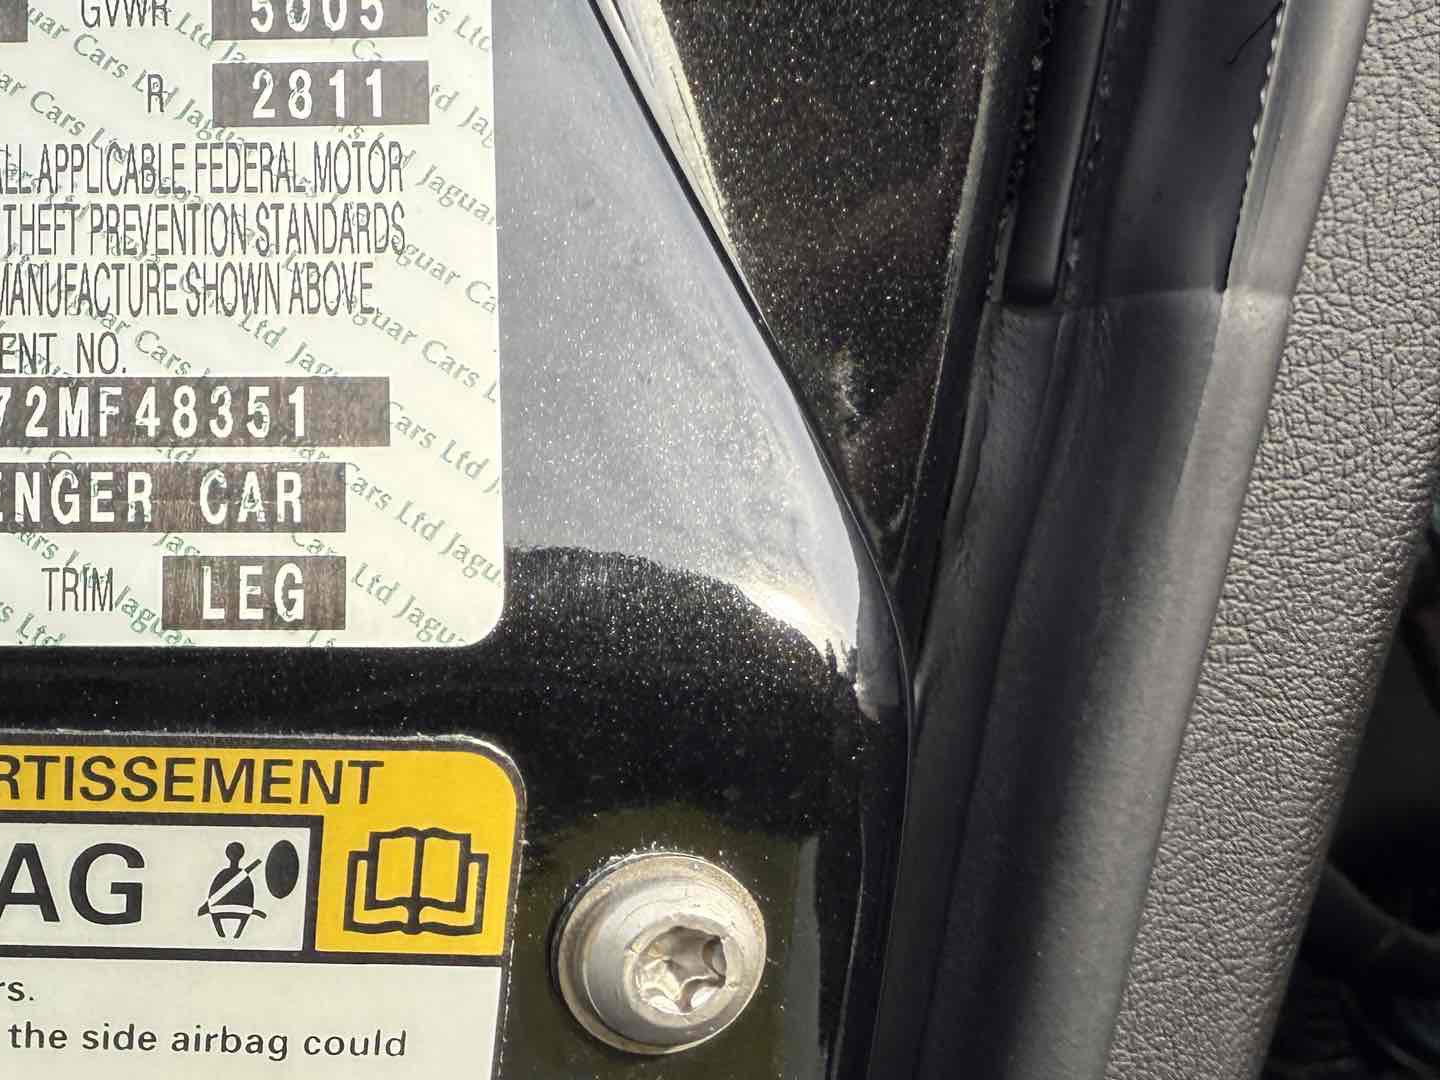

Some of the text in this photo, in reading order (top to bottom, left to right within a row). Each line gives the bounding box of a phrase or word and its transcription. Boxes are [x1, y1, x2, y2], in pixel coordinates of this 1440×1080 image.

[81, 0, 171, 29] GVWR
[148, 73, 166, 113] R
[252, 68, 384, 119] 2811
[38, 143, 186, 195] APPLICABLE
[195, 142, 307, 194] FEDERAL
[313, 140, 404, 194] MOTOR
[415, 164, 496, 226] Jagua
[3, 204, 81, 256] THEFT
[90, 203, 247, 256] PREVENTION
[255, 201, 407, 256] STANDARDS
[186, 261, 282, 317] SHOWN
[76, 331, 127, 374] NO.
[199, 468, 303, 525] CAR
[41, 566, 114, 613] TRIM
[201, 562, 305, 623] LEG
[7, 1021, 69, 1050] the
[81, 1022, 158, 1052] side
[171, 1024, 289, 1062] airbag
[303, 1029, 408, 1058] could
